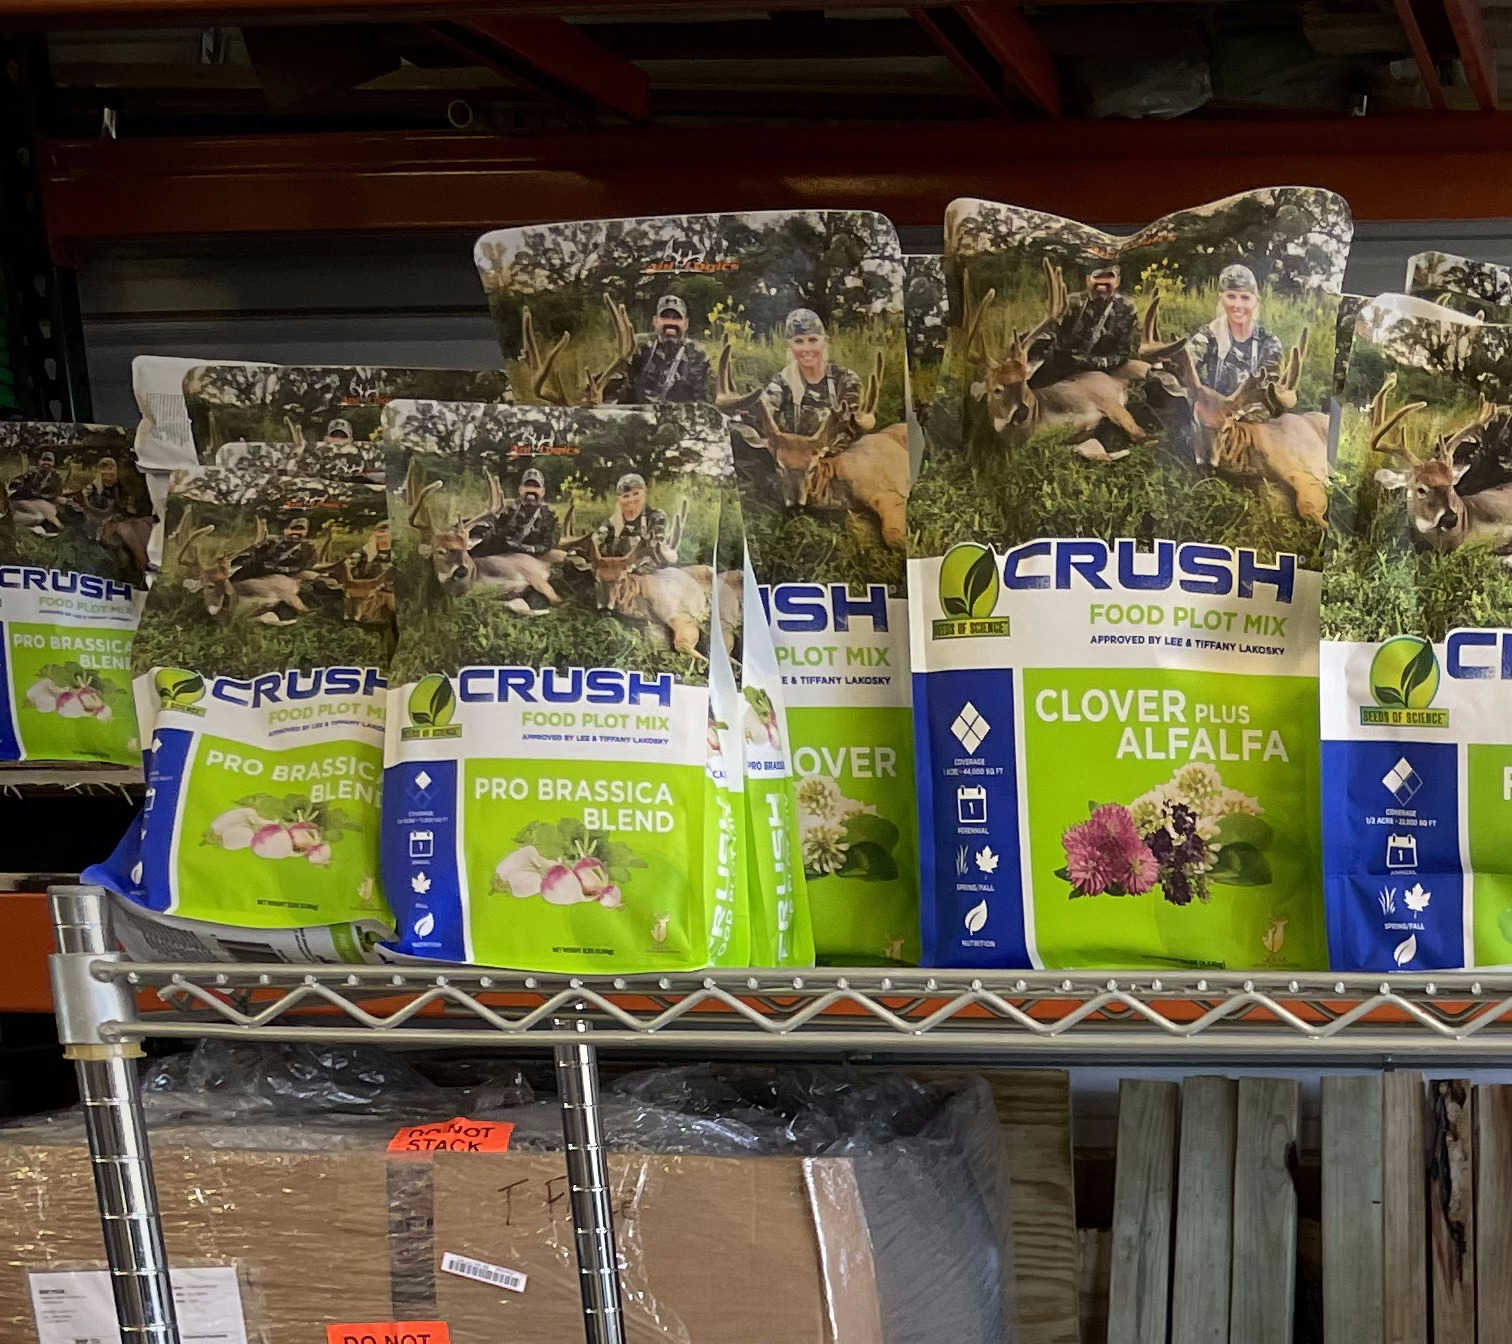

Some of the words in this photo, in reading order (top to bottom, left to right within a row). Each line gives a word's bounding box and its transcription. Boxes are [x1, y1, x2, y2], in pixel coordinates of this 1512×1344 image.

[1004, 540, 1296, 604] CRUSH
[1089, 604, 1165, 626] FOOD
[1173, 606, 1235, 633] PLOT
[1243, 614, 1288, 638] MIX
[13, 634, 46, 649] PRO
[1090, 634, 1145, 646] APPROVED
[1148, 636, 1161, 646] BY
[1164, 637, 1183, 647] LEE
[1195, 640, 1237, 653] TIFFANY
[1239, 644, 1285, 657] LAKOSKY
[846, 646, 890, 666] MIX
[459, 668, 672, 708] CRUSH
[268, 707, 314, 725] FOOD
[318, 704, 359, 720] PLOT
[1035, 688, 1186, 724] CLOVER
[1195, 704, 1251, 725] PLUS
[1392, 710, 1403, 724] OF
[1405, 709, 1444, 724] SCIENCE
[522, 711, 576, 729] FOOD
[582, 712, 630, 730] PLOT
[635, 715, 670, 732] MIX
[1116, 726, 1290, 763] ALFALFA
[205, 749, 264, 777] PRO
[474, 777, 529, 801] PRO
[538, 778, 674, 806] BRASSICA
[583, 808, 674, 833] BLEND
[448, 1123, 495, 1138] NOT
